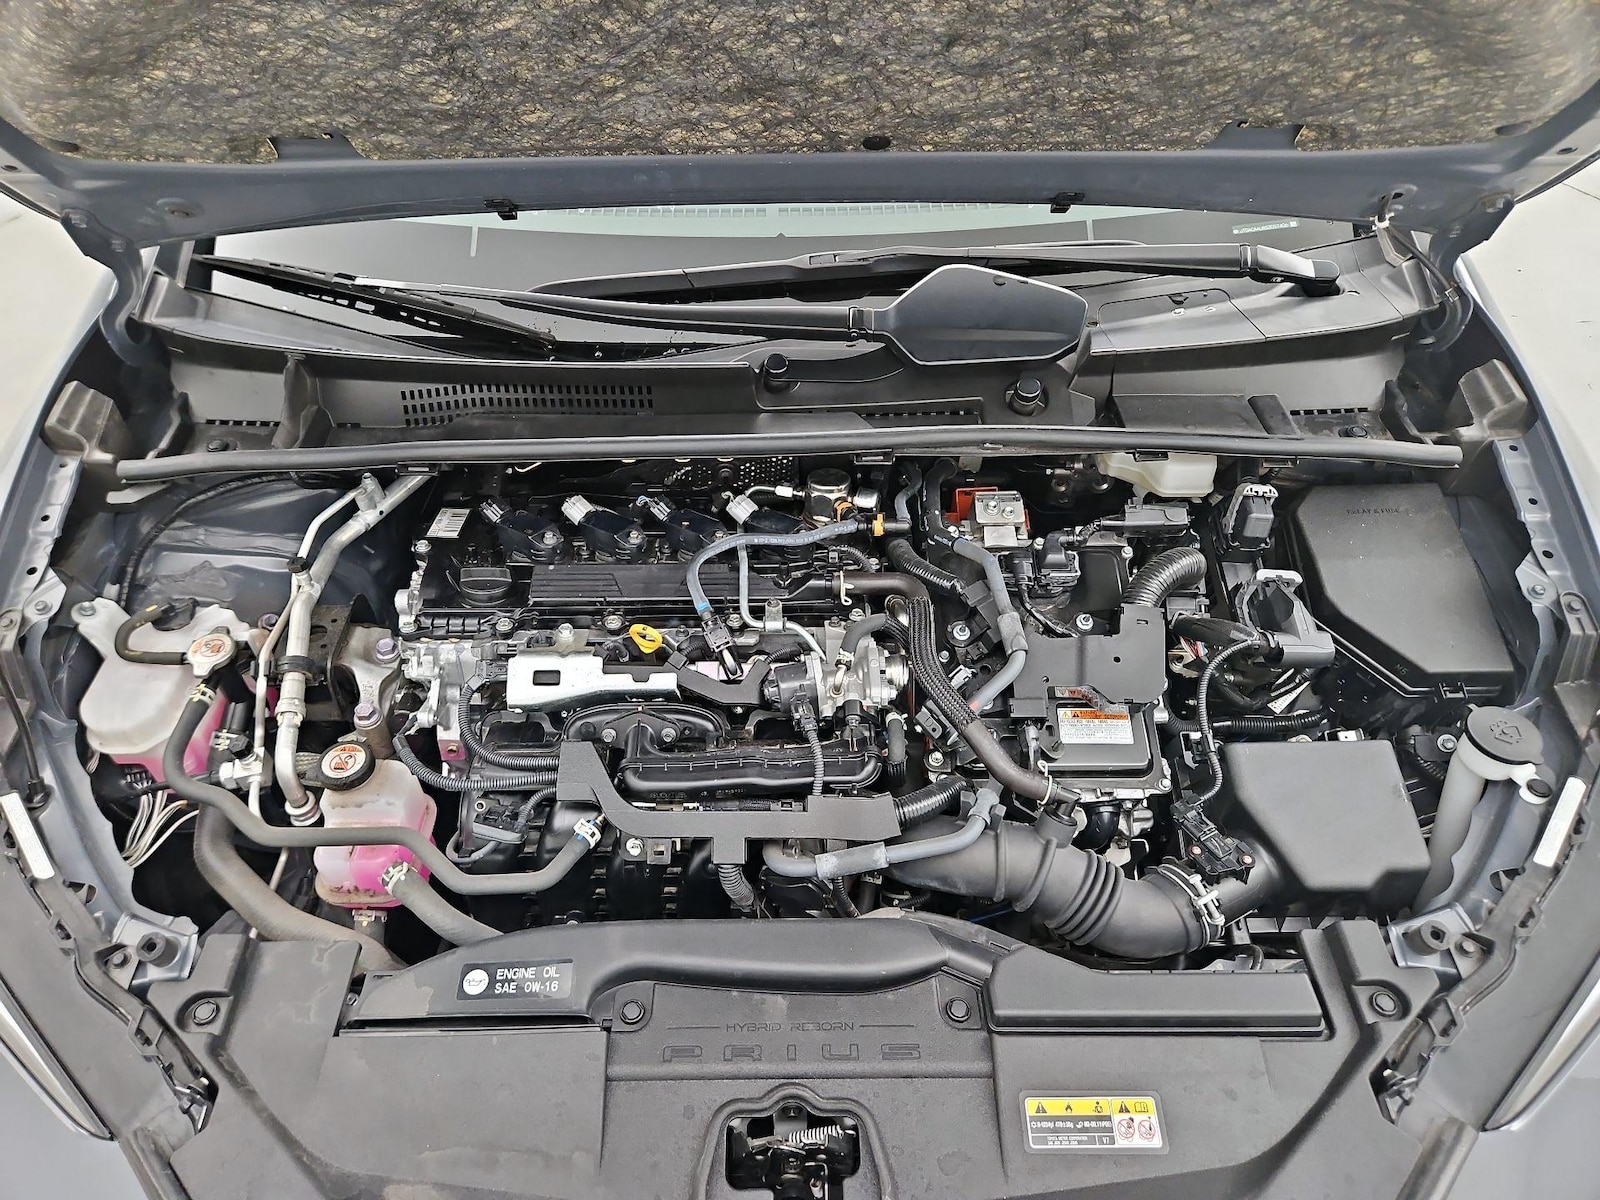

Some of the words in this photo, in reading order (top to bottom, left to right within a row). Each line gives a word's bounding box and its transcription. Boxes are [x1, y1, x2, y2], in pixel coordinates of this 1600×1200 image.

[496, 967, 536, 980] ENGINE
[543, 966, 560, 978] OIL
[494, 982, 517, 994] SAE
[524, 980, 559, 993] 0W-16
[725, 1022, 782, 1032] HYBRID
[790, 1021, 855, 1031] REBORN
[662, 1043, 921, 1063] PRIUS
